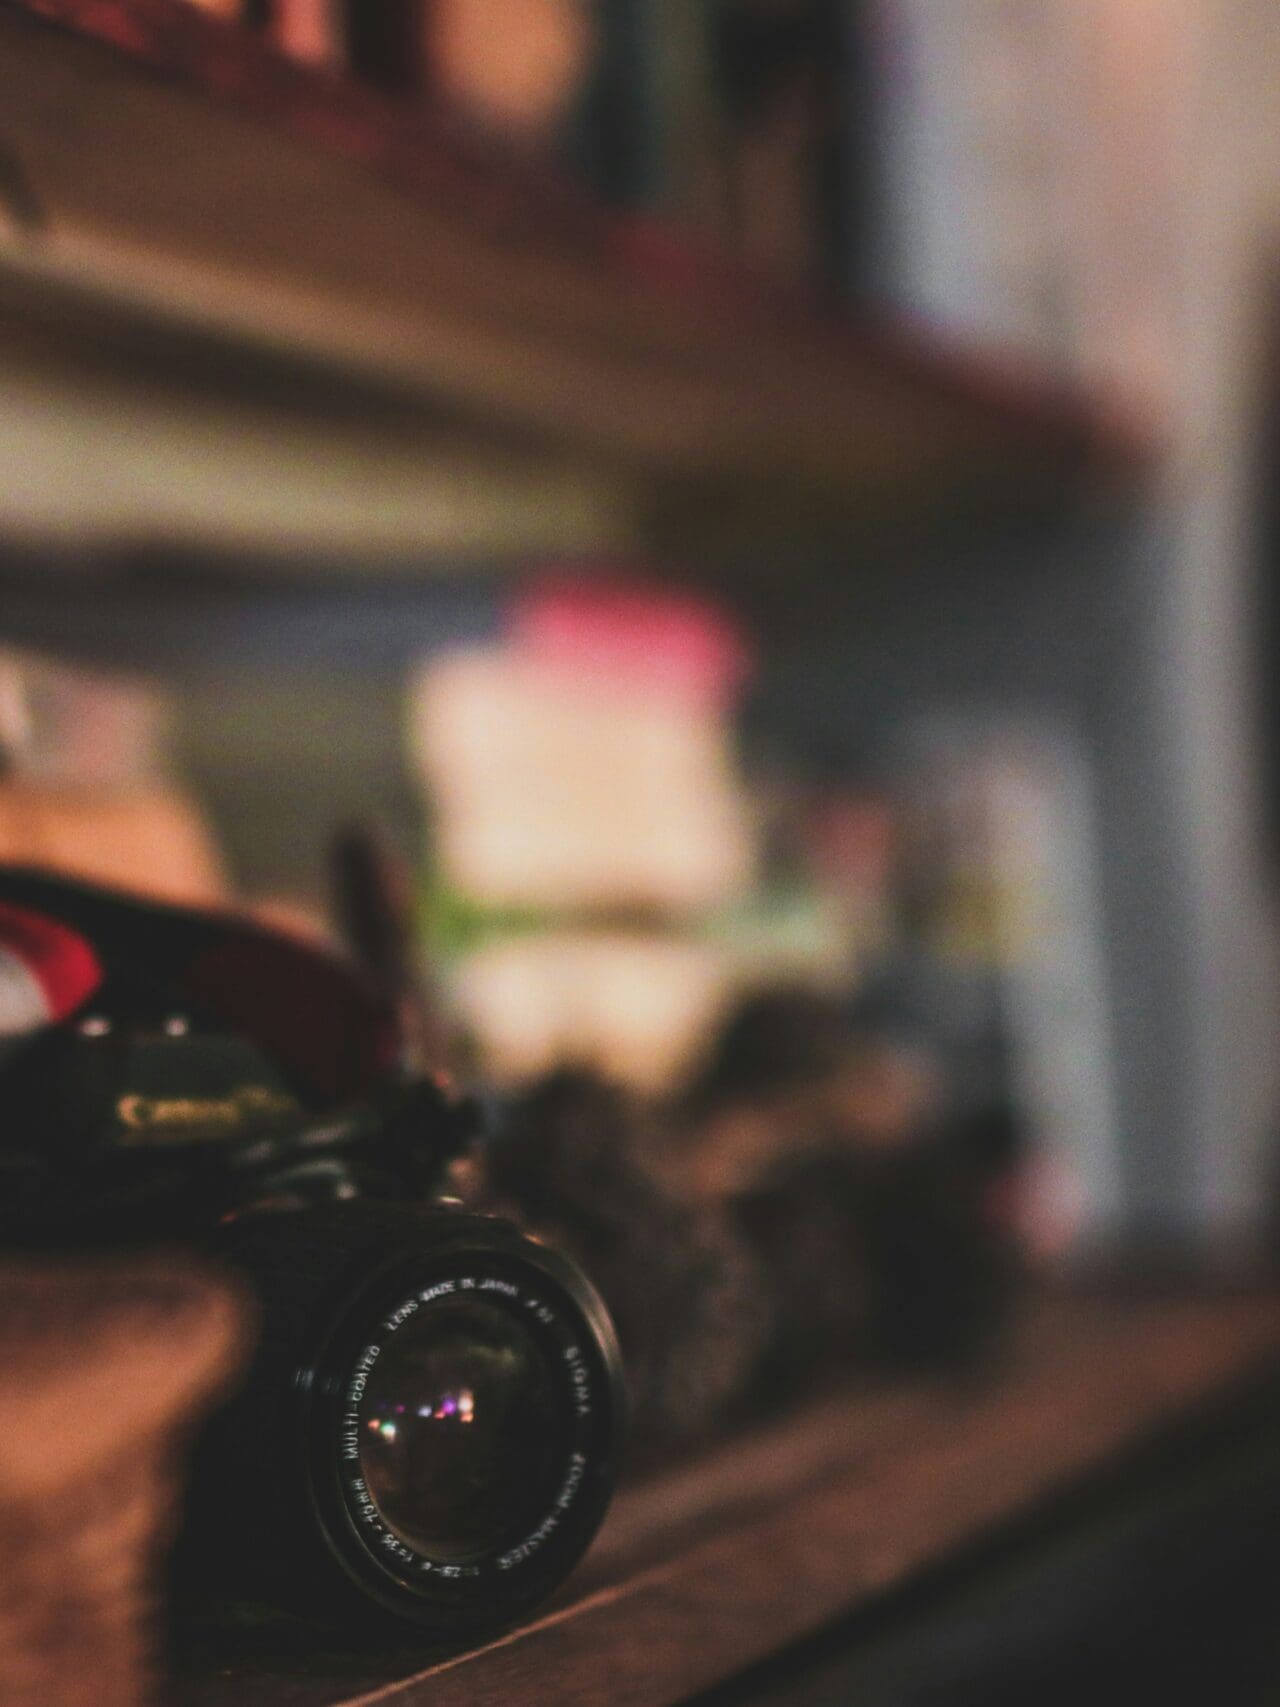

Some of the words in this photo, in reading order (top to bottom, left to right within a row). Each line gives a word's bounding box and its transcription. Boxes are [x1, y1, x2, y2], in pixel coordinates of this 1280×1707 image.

[385, 1300, 419, 1330] LENS
[419, 1280, 456, 1301] MADE
[460, 1278, 475, 1290] IN
[478, 1278, 519, 1296] JAPAN
[343, 1345, 380, 1460] MULTI-COATED
[563, 1346, 590, 1417] SIGMA
